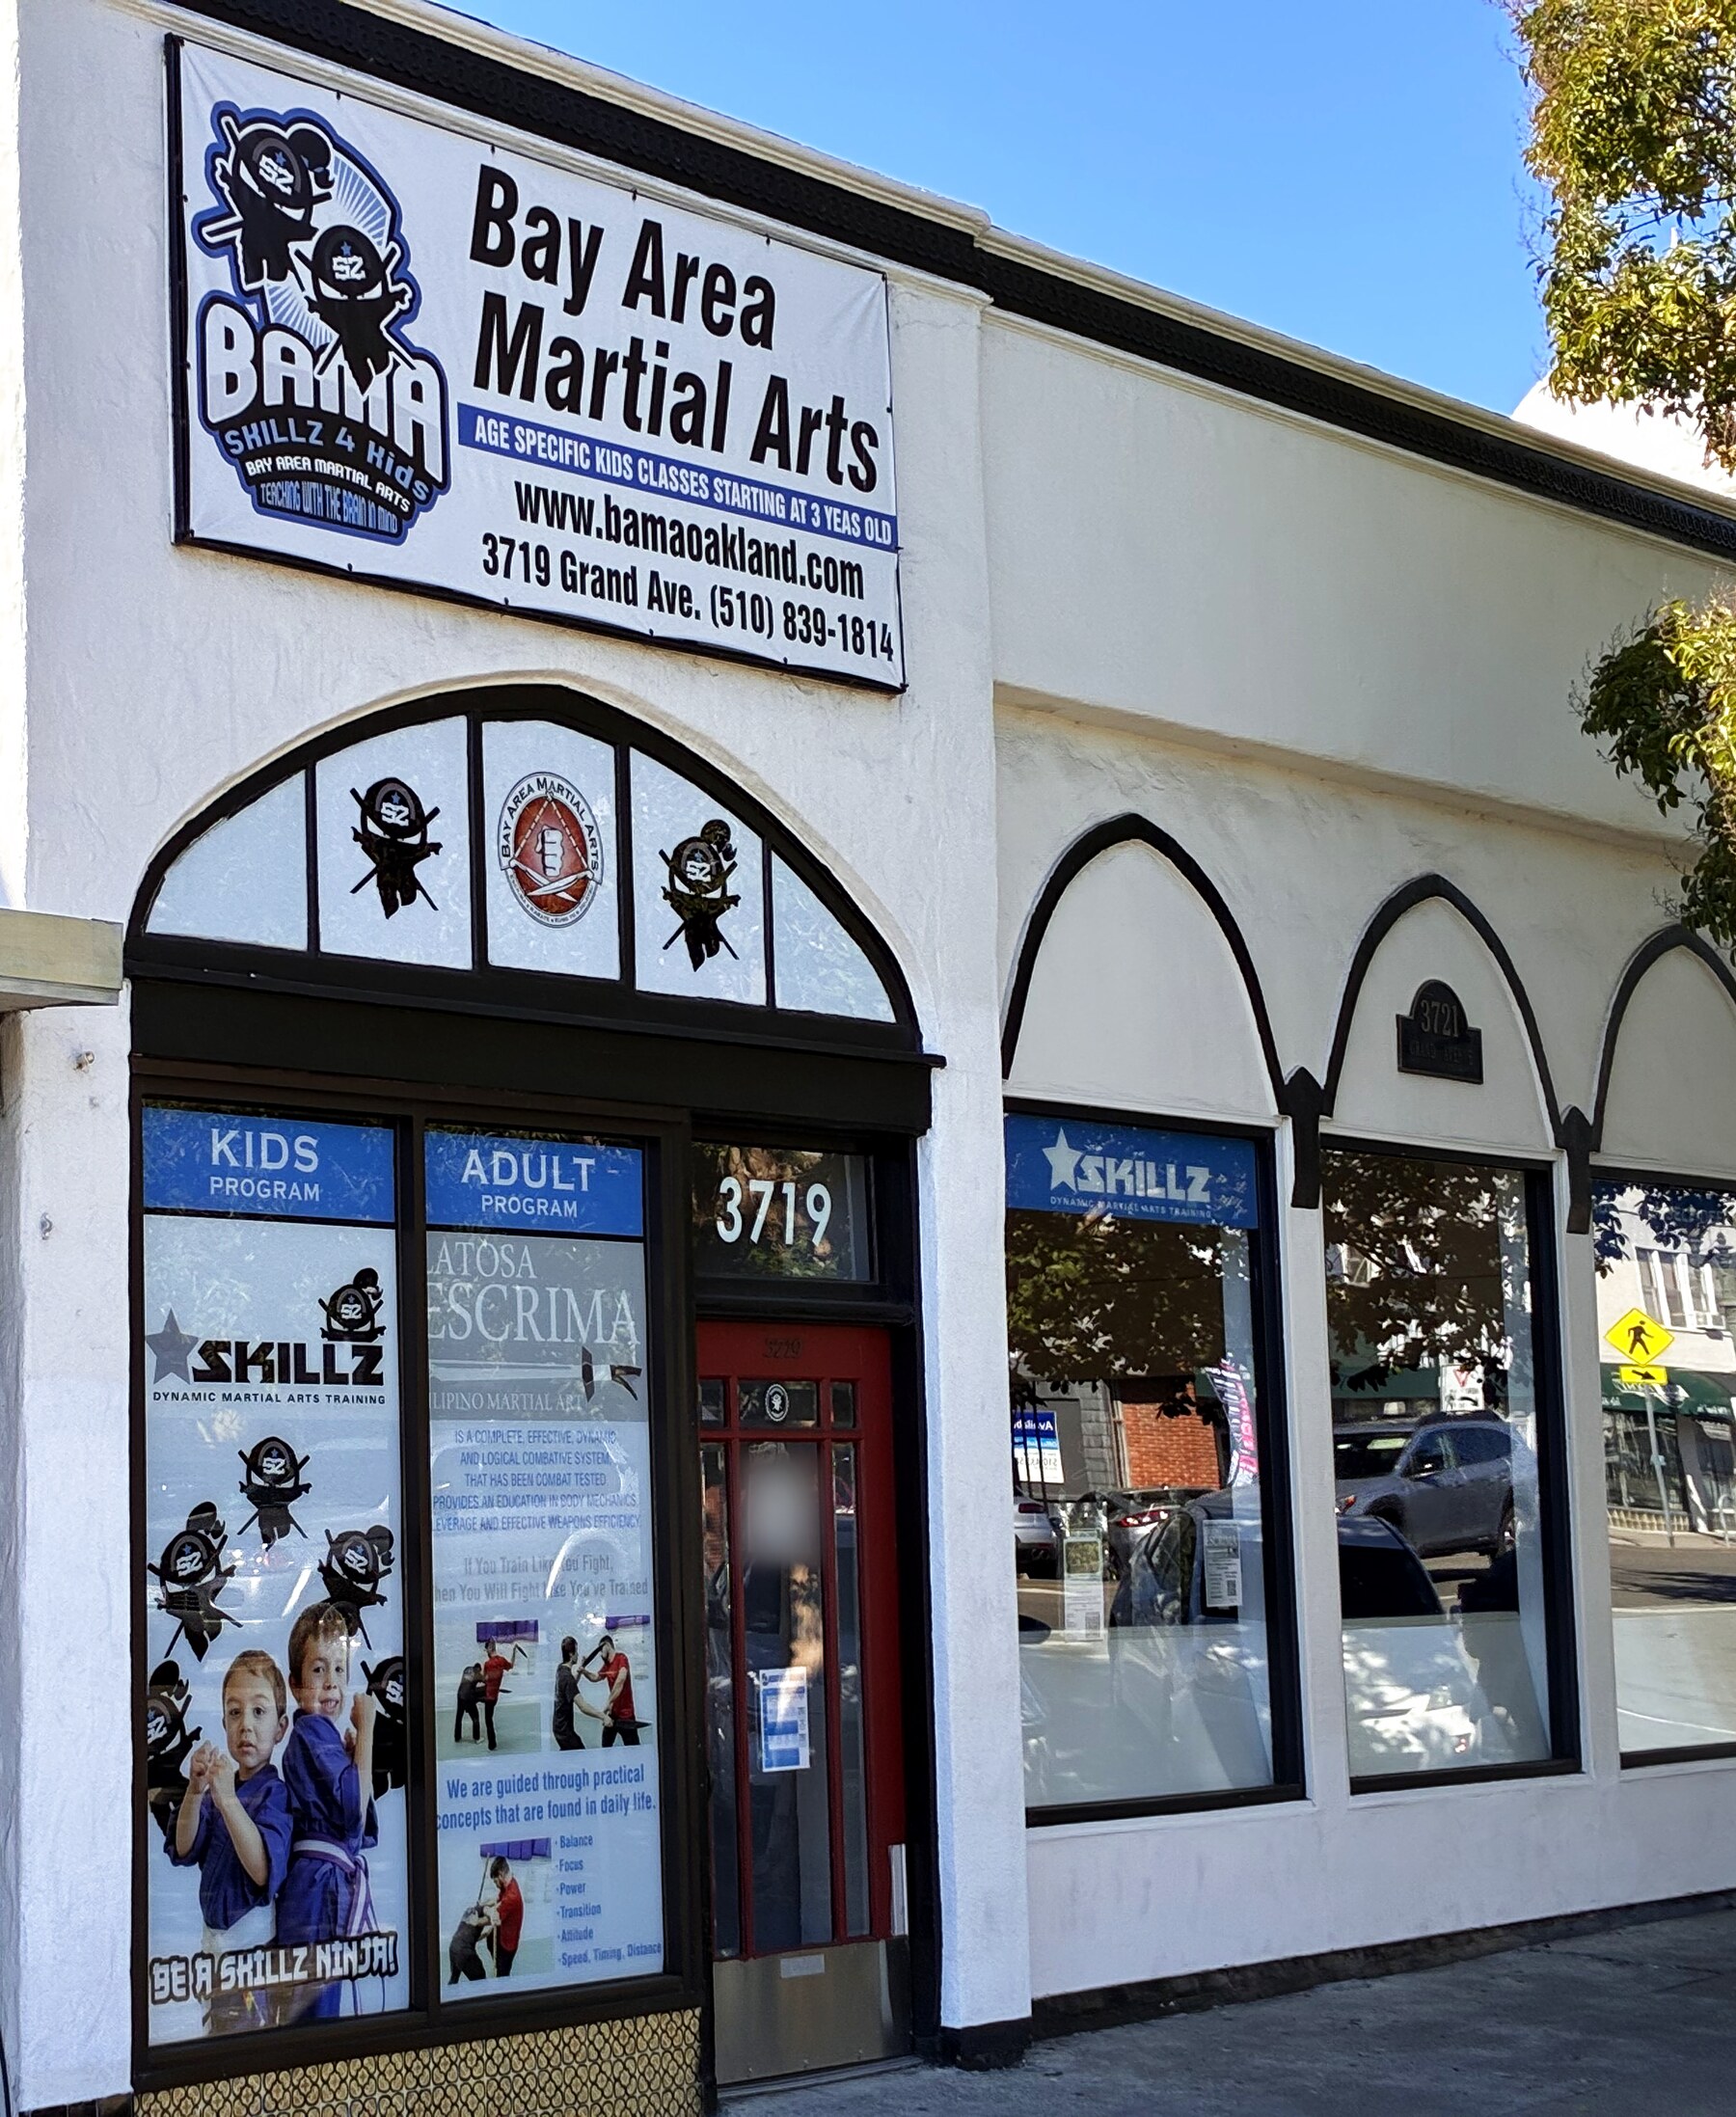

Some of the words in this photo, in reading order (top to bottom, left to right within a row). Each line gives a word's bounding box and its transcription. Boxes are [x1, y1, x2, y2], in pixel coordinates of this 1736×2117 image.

[469, 164, 605, 316] Bay
[621, 218, 776, 351] Area
[203, 301, 445, 482] BAMA
[473, 290, 732, 454] Martial
[749, 374, 880, 493] Arts
[224, 418, 324, 455] SKILLZ
[335, 426, 356, 453] 4
[366, 440, 429, 502] Kids
[245, 456, 273, 476] BAY
[276, 455, 312, 472] AREA
[314, 459, 373, 491] MARTIAL
[375, 484, 411, 513] ARTS
[475, 415, 510, 450] AGE
[514, 425, 590, 471] SPECIFIC
[595, 446, 634, 481] KIDS
[637, 457, 710, 500] CLASSES
[714, 476, 786, 519] STARTING
[790, 497, 807, 525] AT
[810, 502, 821, 528] 3
[824, 504, 861, 538] YEAS
[864, 515, 892, 546] OLD
[302, 481, 324, 517] WITH
[324, 484, 341, 522] THE
[514, 480, 865, 600] www.bamaoakland.com
[482, 532, 551, 587] 3719
[560, 550, 638, 608] Grand
[647, 570, 701, 620] Ave.
[710, 584, 773, 640] (510)
[783, 601, 894, 662] 839-1814
[506, 783, 534, 820] AREA
[536, 777, 586, 822] MARTIAL
[502, 821, 512, 857] BAY
[584, 824, 600, 871] ARTS
[1421, 999, 1459, 1038] 3721
[210, 1127, 319, 1174] KIDS
[209, 1176, 320, 1202] PROGRAM
[460, 1149, 596, 1192] ADULT
[1077, 1154, 1210, 1203] SKILLZ
[481, 1194, 578, 1218] PROGRAM
[717, 1176, 832, 1247] 3719
[427, 1239, 537, 1279] ATOSA
[427, 1282, 641, 1344] ESCRIMA
[192, 1340, 385, 1386] SKILLZ
[152, 1392, 216, 1403] DYNAMIC
[222, 1393, 282, 1404] MARTIAL
[286, 1394, 320, 1404] ARTS
[325, 1395, 386, 1405] TRAINING
[487, 1392, 552, 1411] MARTIAL
[455, 1429, 464, 1443] IS
[467, 1430, 473, 1443] A
[460, 1452, 479, 1465] AND
[482, 1452, 520, 1465] LOGICAL
[524, 1451, 572, 1465] COMBATIVE
[465, 1474, 487, 1486] THAT
[490, 1474, 508, 1486] HAS
[511, 1473, 533, 1486] BEEN
[536, 1473, 572, 1486] COMBAT
[433, 1496, 478, 1509] PROVIDES
[482, 1495, 494, 1508] AN
[497, 1495, 546, 1508] EDUCATION
[549, 1494, 557, 1507] IN
[560, 1494, 583, 1507] BODY
[480, 1517, 499, 1531] AND
[502, 1516, 546, 1531] EFFECTIVE
[548, 1514, 592, 1529] WEAPONS
[465, 1558, 472, 1575] If
[475, 1557, 496, 1574] You
[500, 1556, 529, 1573] Train
[583, 1555, 614, 1575] Fight,
[458, 1583, 480, 1601] You
[484, 1583, 507, 1600] Will
[511, 1582, 540, 1602] Fight
[448, 1778, 468, 1799] We
[472, 1779, 493, 1798] are
[497, 1772, 539, 1800] guided
[543, 1768, 590, 1793] through
[593, 1763, 644, 1788] practical
[437, 1806, 492, 1832] concepts
[496, 1803, 521, 1824] that
[524, 1805, 544, 1822] are
[548, 1799, 582, 1818] found
[585, 1797, 597, 1815] in
[601, 1793, 630, 1816] daily
[634, 1792, 657, 1810] life.
[559, 1833, 593, 1849] Balance
[559, 1859, 583, 1872] Focus
[559, 1883, 586, 1896] Power
[559, 1902, 602, 1919] Transition
[152, 1956, 188, 2001] BE
[195, 1956, 213, 1995] A
[220, 1946, 309, 1991] SKILLZ
[315, 1935, 396, 1978] NINJA!
[627, 1942, 662, 1958] Distance
